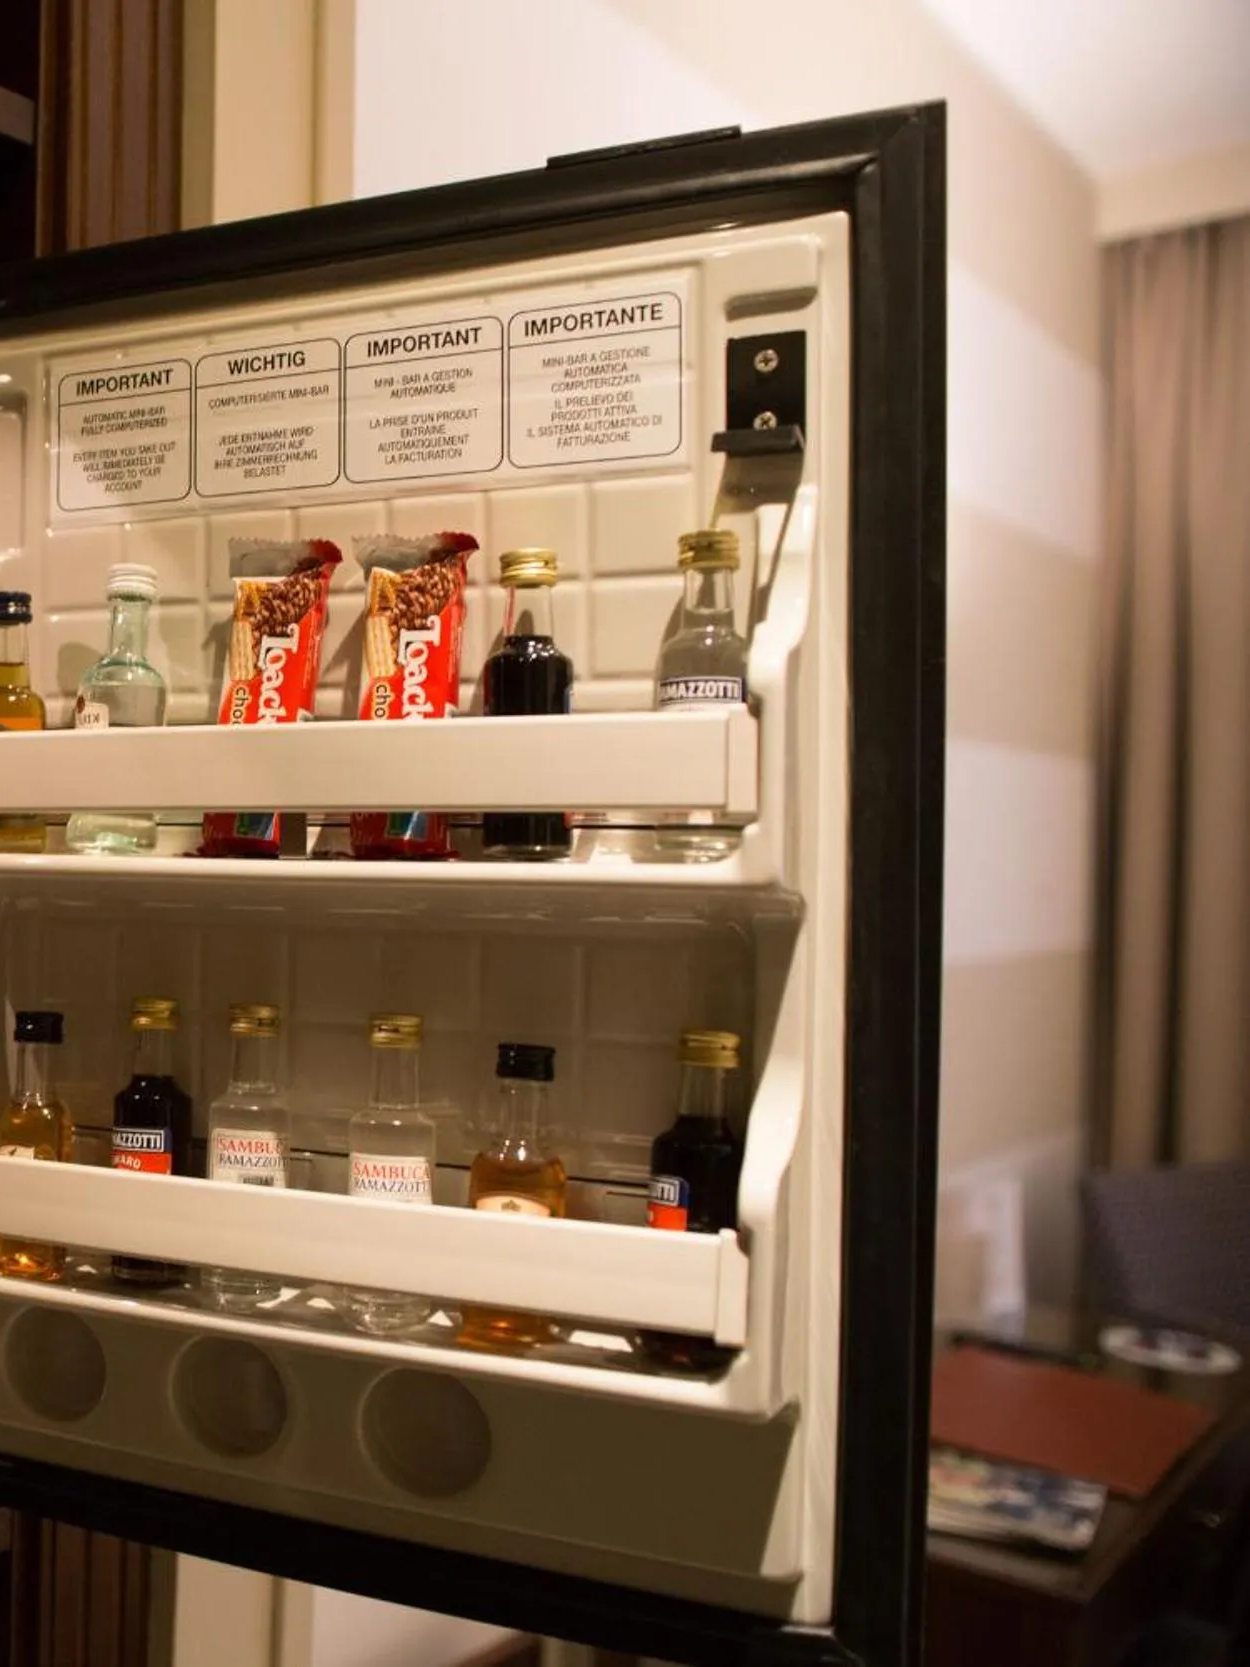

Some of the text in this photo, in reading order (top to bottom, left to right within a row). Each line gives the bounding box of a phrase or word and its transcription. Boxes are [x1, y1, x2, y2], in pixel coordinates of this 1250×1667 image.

[524, 303, 663, 337] IMPORTANTE
[368, 326, 482, 358] IMPORTANT
[228, 351, 306, 375] WICHTIG
[542, 346, 650, 368] MINI-BAR A GESTIONE
[374, 377, 394, 388] MINI
[402, 374, 420, 386] BAR
[423, 373, 428, 382] A
[432, 368, 472, 381] GESTION
[564, 362, 628, 379] AUTOMATICA
[76, 368, 174, 397] IMPORTANT
[390, 382, 455, 399] AUTOMATIQUE
[551, 374, 641, 393] COMPUTERIZZATA
[208, 384, 329, 409] COMPUTERISIERTE MINI-BAR
[555, 391, 633, 409] IL PRELIEVO DEI
[83, 411, 127, 424] AUTOMATIC
[370, 418, 380, 429] LA
[383, 415, 409, 426] PRISE
[436, 408, 478, 422] PRODUIT
[551, 405, 637, 422] PRODOTTI ATTIVA
[81, 417, 167, 436] FULLY COMPUTERIZED
[538, 423, 580, 437] SISTEMA
[583, 416, 649, 432] AUTOMATICO
[652, 415, 662, 425] DI
[219, 426, 314, 446] JEDE ENTNAHME WIRD
[378, 434, 469, 452] AUTOMATIQUEMENT
[557, 432, 631, 448] FATTURAZIONE
[99, 449, 117, 459] ITEM
[120, 448, 135, 456] YOU
[159, 441, 176, 452] OUT
[226, 438, 305, 456] AUTOMATISCH AUF
[103, 456, 153, 469] IMMEDIATELY
[236, 449, 318, 467] ZIMMERRECHNUNG
[385, 448, 462, 465] LA FACTURATION
[127, 470, 137, 479] TO
[244, 465, 286, 478] BELASTET
[105, 480, 142, 493] ACCOUNT
[661, 681, 739, 698] MAZZOTTI
[352, 1161, 430, 1179] SAMBUCA
